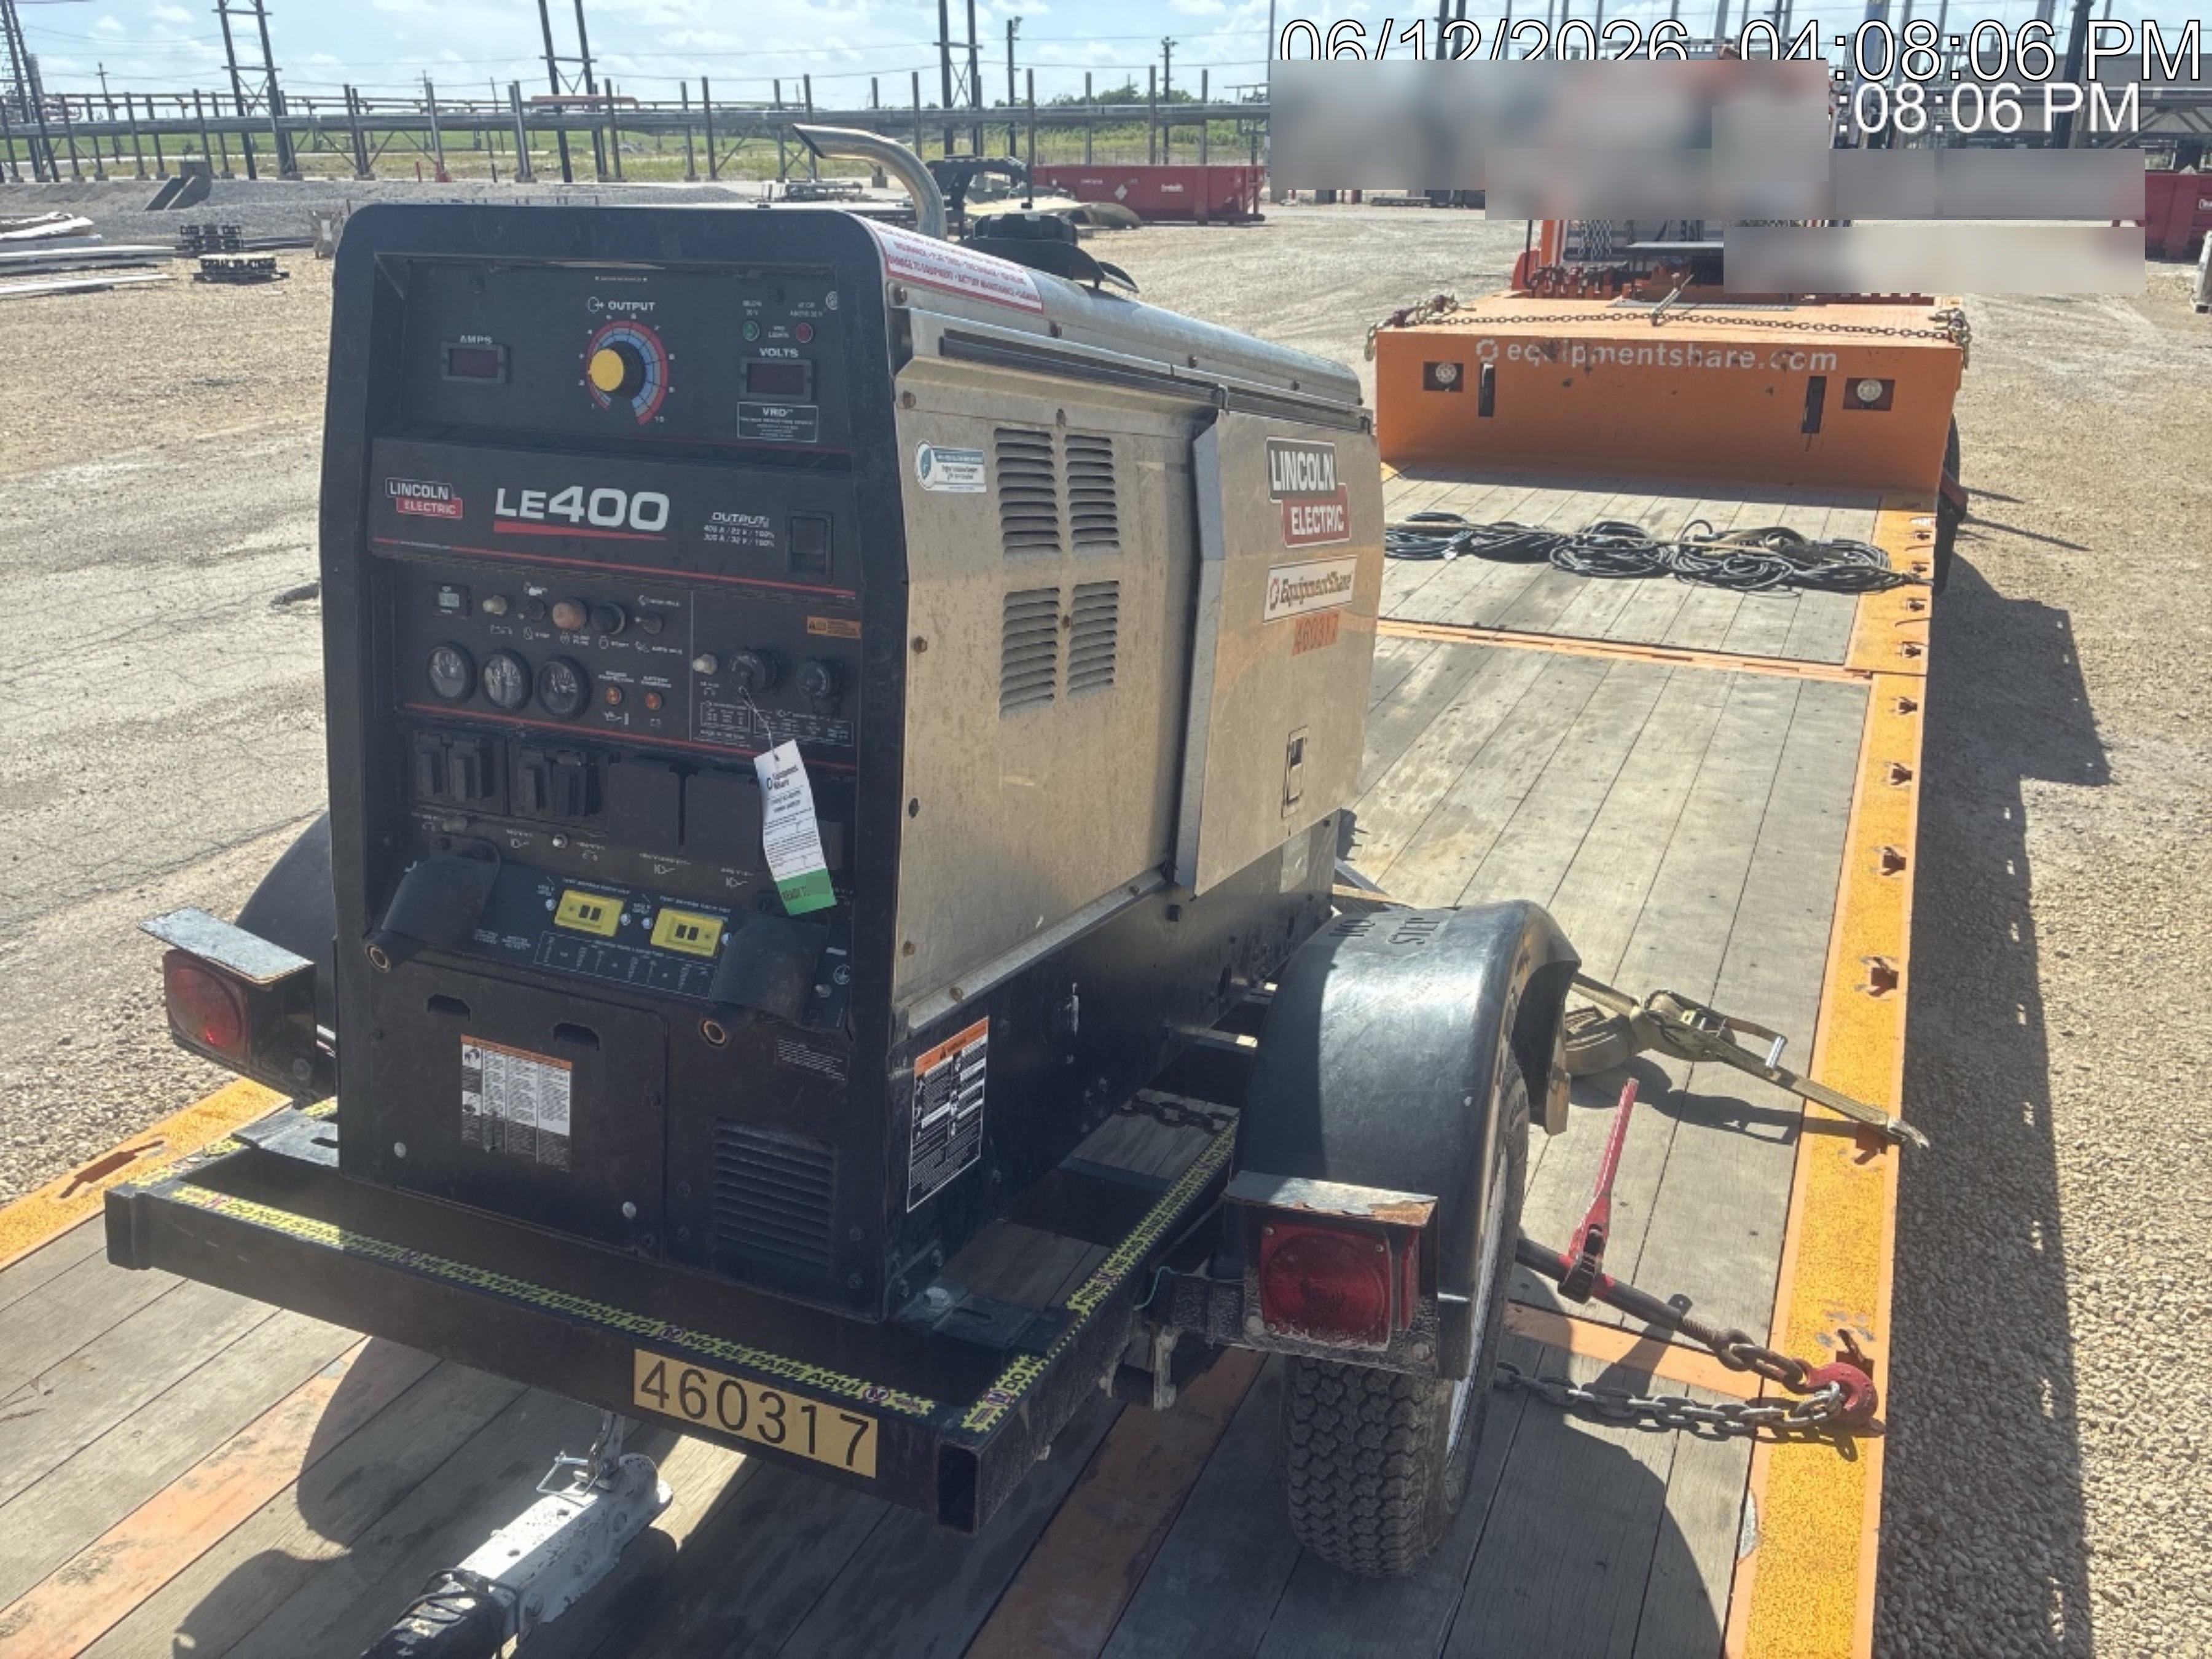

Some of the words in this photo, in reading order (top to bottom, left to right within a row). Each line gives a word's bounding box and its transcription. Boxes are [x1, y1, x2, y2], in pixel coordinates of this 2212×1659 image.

[608, 300, 656, 311] OUTPUT
[460, 335, 492, 345] AMPS
[759, 347, 799, 358] VOLTS
[1507, 339, 1838, 371] eqipmentshare.com
[1269, 449, 1336, 492] LINCOLN
[389, 480, 449, 501] LINCOLN
[404, 500, 457, 516] ELECTRIC
[495, 485, 670, 531] LE400
[1291, 504, 1345, 535] ELECTRIC
[682, 1332, 716, 1351] NO
[804, 1369, 861, 1394] AQUI
[640, 1359, 869, 1467] 460317
